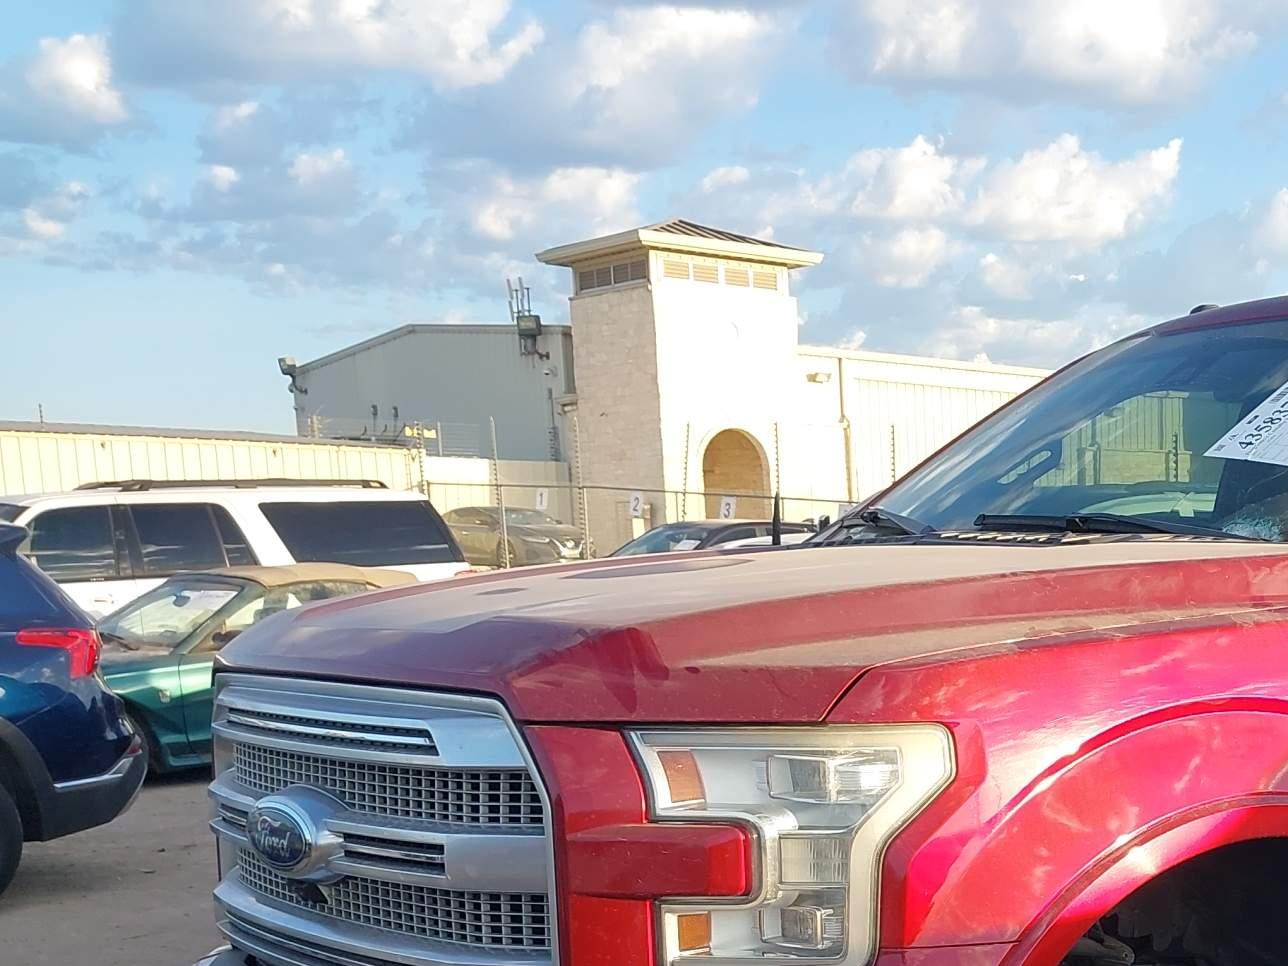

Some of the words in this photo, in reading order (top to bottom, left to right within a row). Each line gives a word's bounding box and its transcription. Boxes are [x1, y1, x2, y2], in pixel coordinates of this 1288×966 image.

[632, 496, 640, 512] 2
[723, 502, 732, 518] 3
[258, 815, 292, 851] Ford
